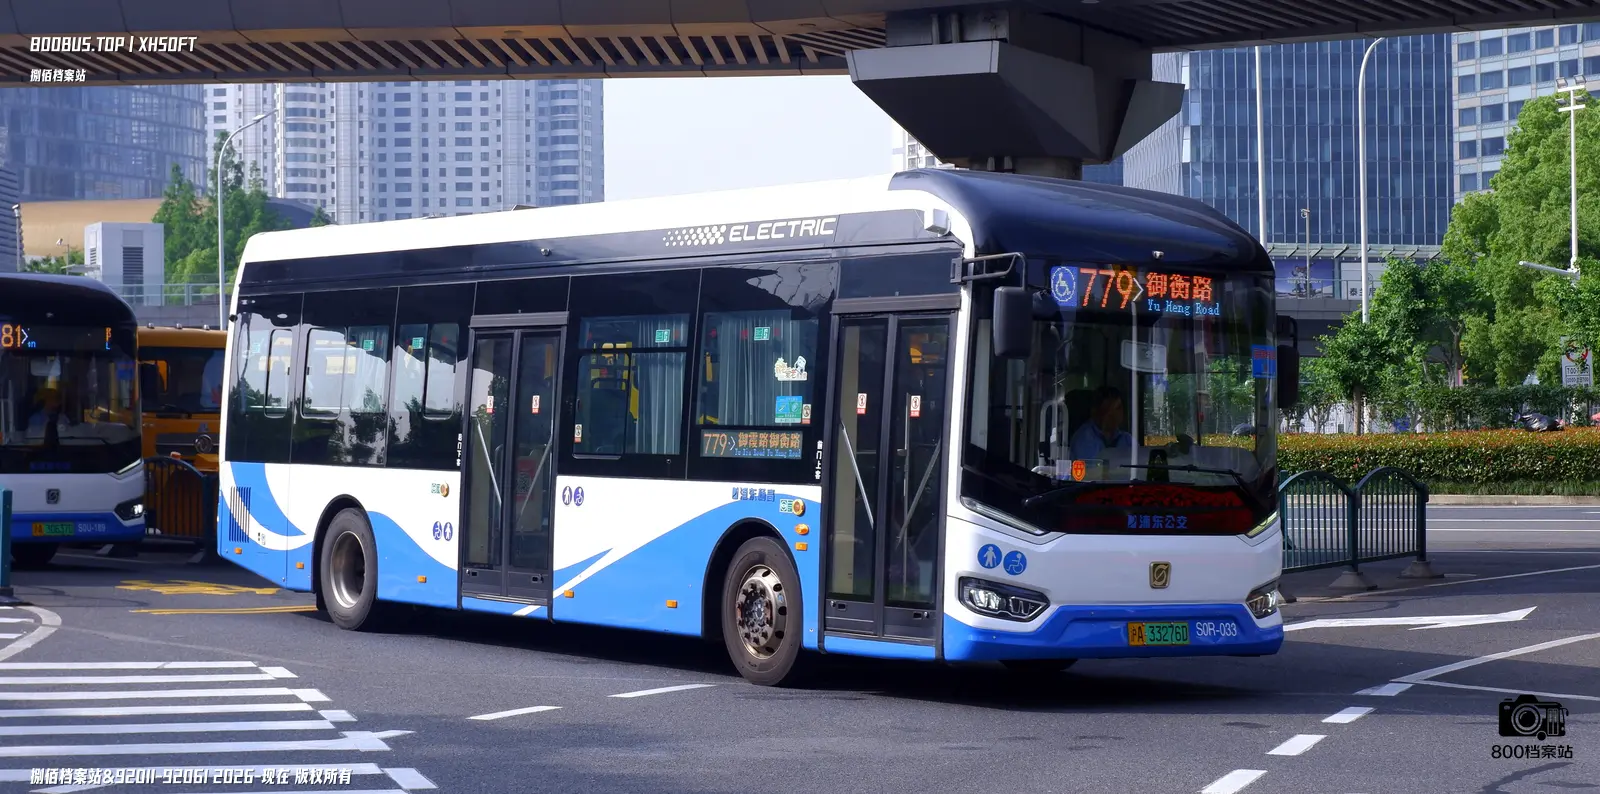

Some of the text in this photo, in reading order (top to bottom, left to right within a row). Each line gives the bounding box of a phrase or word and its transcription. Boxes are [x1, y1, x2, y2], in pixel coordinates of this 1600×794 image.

[729, 217, 837, 242] ELECTRIC
[1079, 267, 1134, 309] 779
[1145, 271, 1213, 302] 御衡路
[1148, 299, 1220, 316] Yu Heng Road
[703, 433, 728, 456] 779
[1138, 514, 1188, 529] 浦东公交
